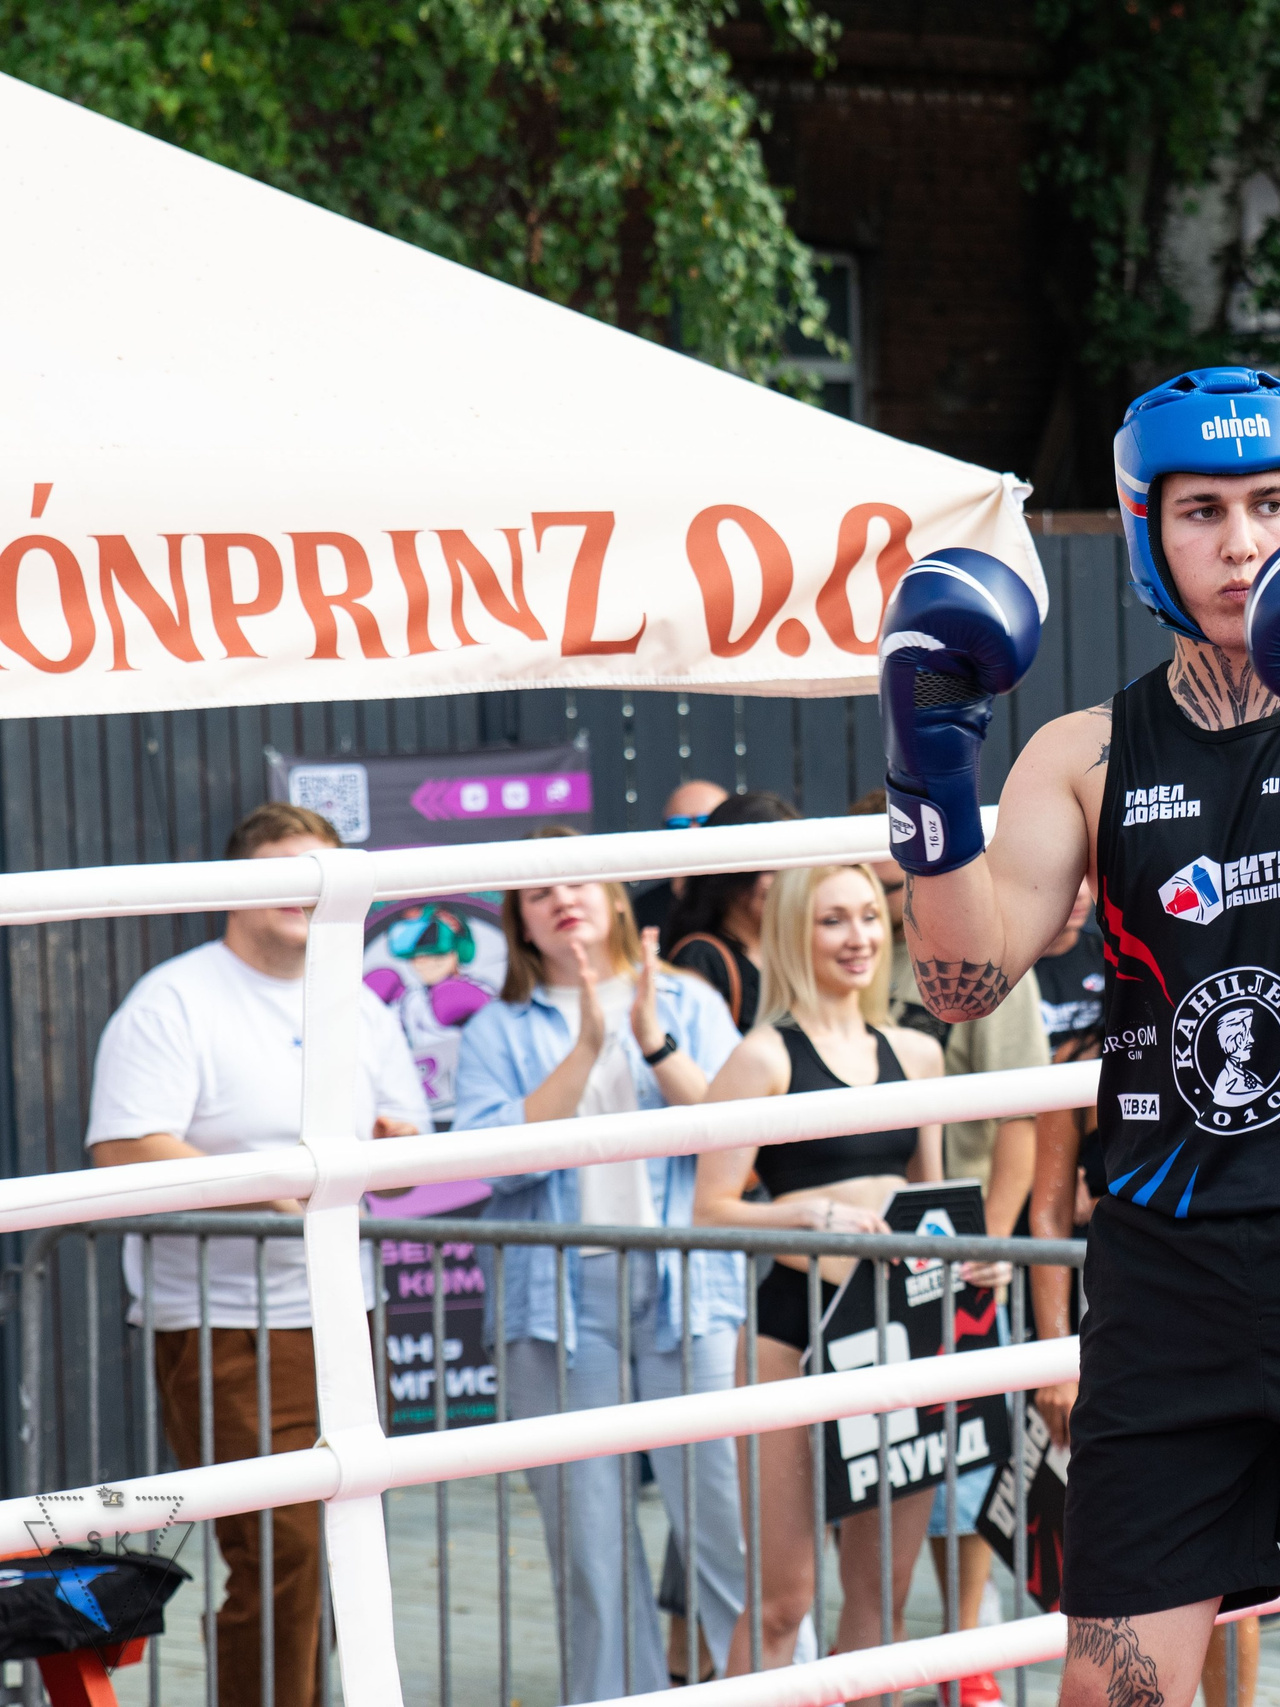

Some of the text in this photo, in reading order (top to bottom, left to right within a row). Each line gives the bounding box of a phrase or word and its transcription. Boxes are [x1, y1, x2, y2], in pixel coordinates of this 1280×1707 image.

[1201, 413, 1271, 441] clinch
[0, 482, 647, 674] ÓNPRINZ
[1125, 784, 1184, 808] ПАВЕЛ
[1122, 799, 1201, 827] ДОВБНЯ
[1127, 1050, 1143, 1061] GIN
[848, 1416, 990, 1503] РАУНД
